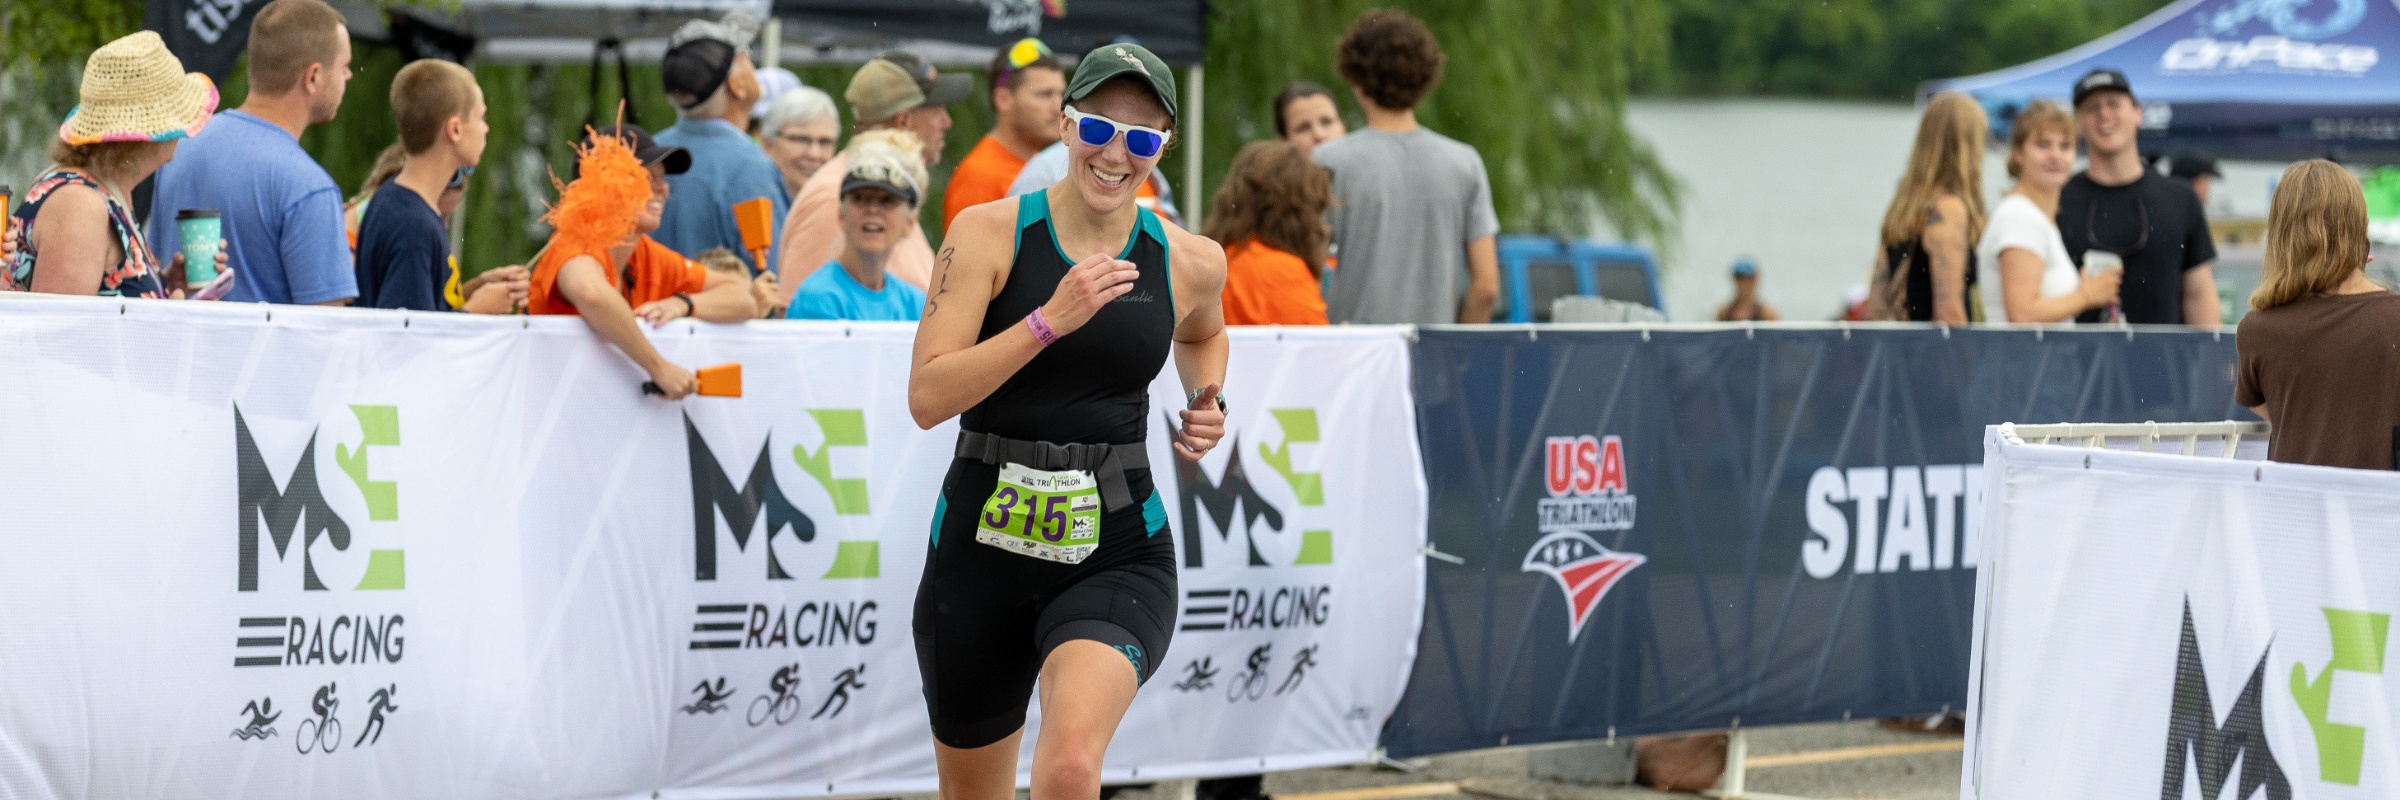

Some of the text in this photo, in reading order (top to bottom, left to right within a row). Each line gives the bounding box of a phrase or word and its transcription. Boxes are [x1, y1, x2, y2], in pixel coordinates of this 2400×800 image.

[233, 399, 405, 592] MSE
[682, 406, 880, 582] MSE
[985, 486, 1068, 542] 315
[1163, 406, 1333, 569] MSE
[1539, 497, 1635, 529] TRIATHLON
[1546, 436, 1626, 496] USA
